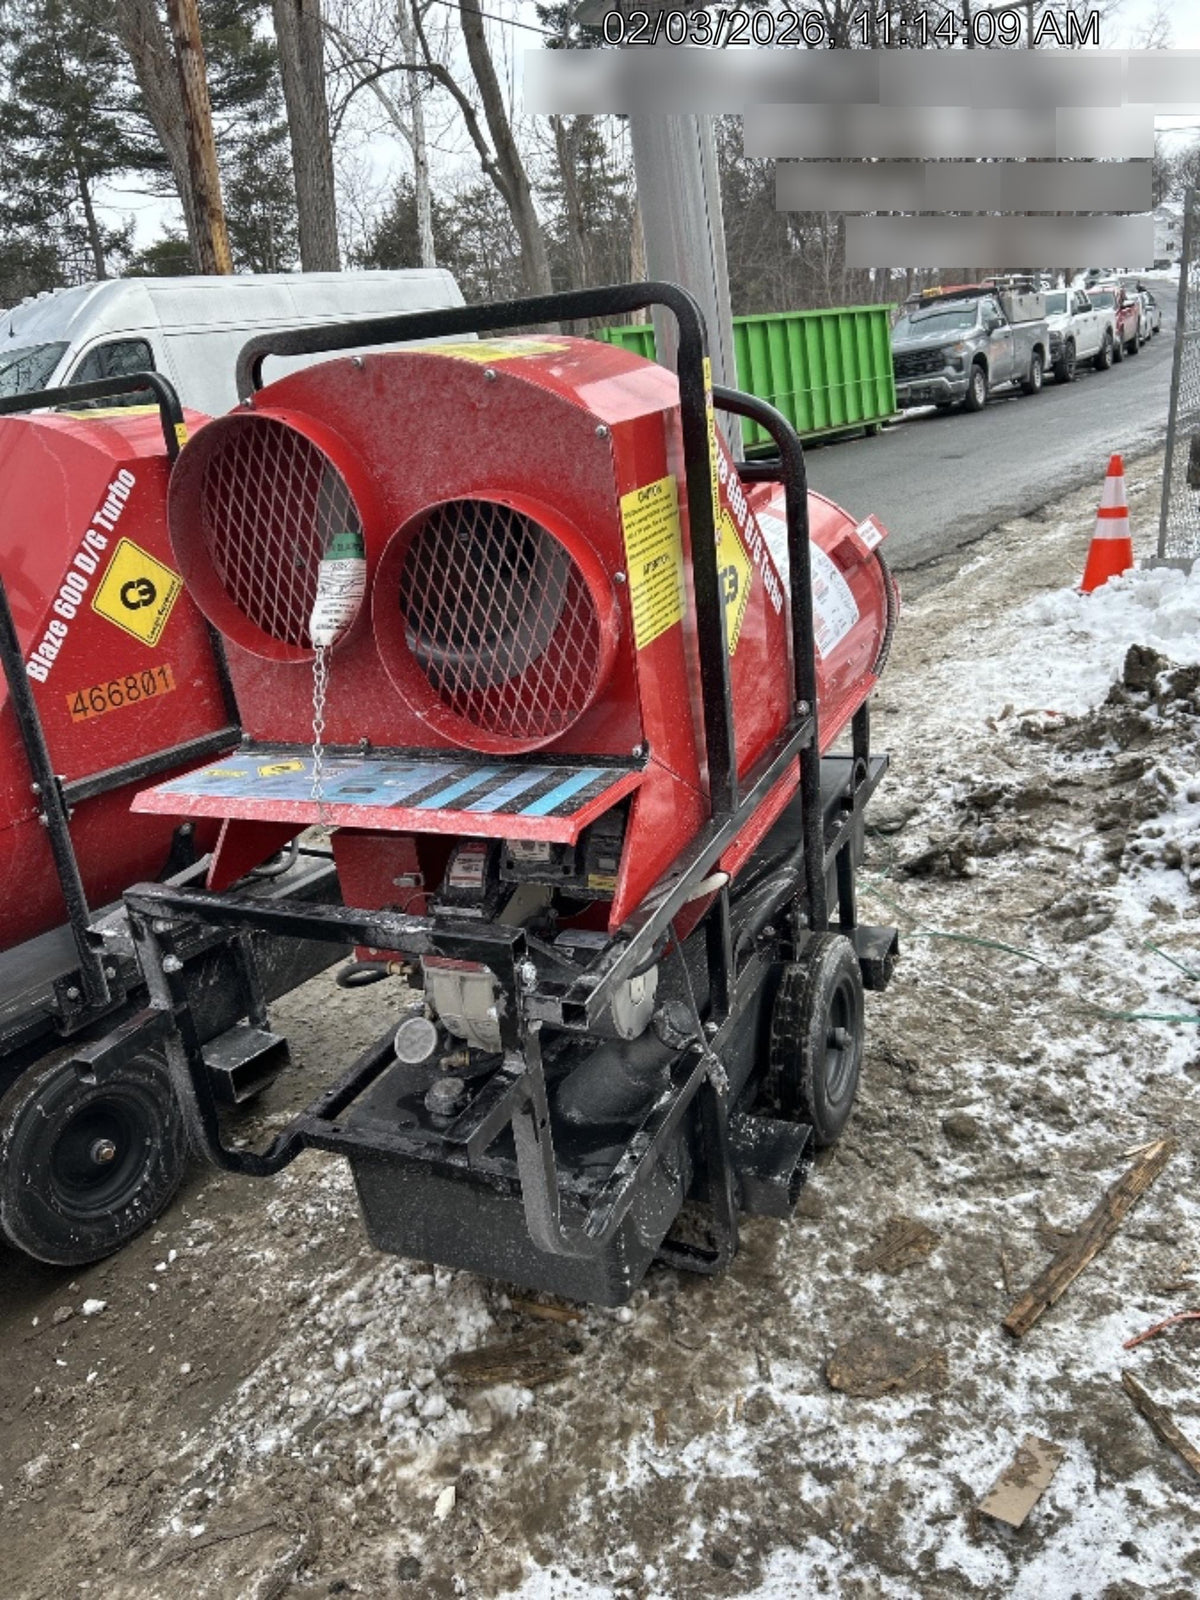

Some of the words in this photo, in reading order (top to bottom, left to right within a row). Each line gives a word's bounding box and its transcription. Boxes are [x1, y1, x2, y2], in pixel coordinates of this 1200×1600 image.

[25, 619, 69, 683] Blaze
[53, 571, 89, 620] 600
[73, 528, 108, 576] D/G
[92, 468, 136, 532] Turbo
[71, 668, 172, 717] 466801
